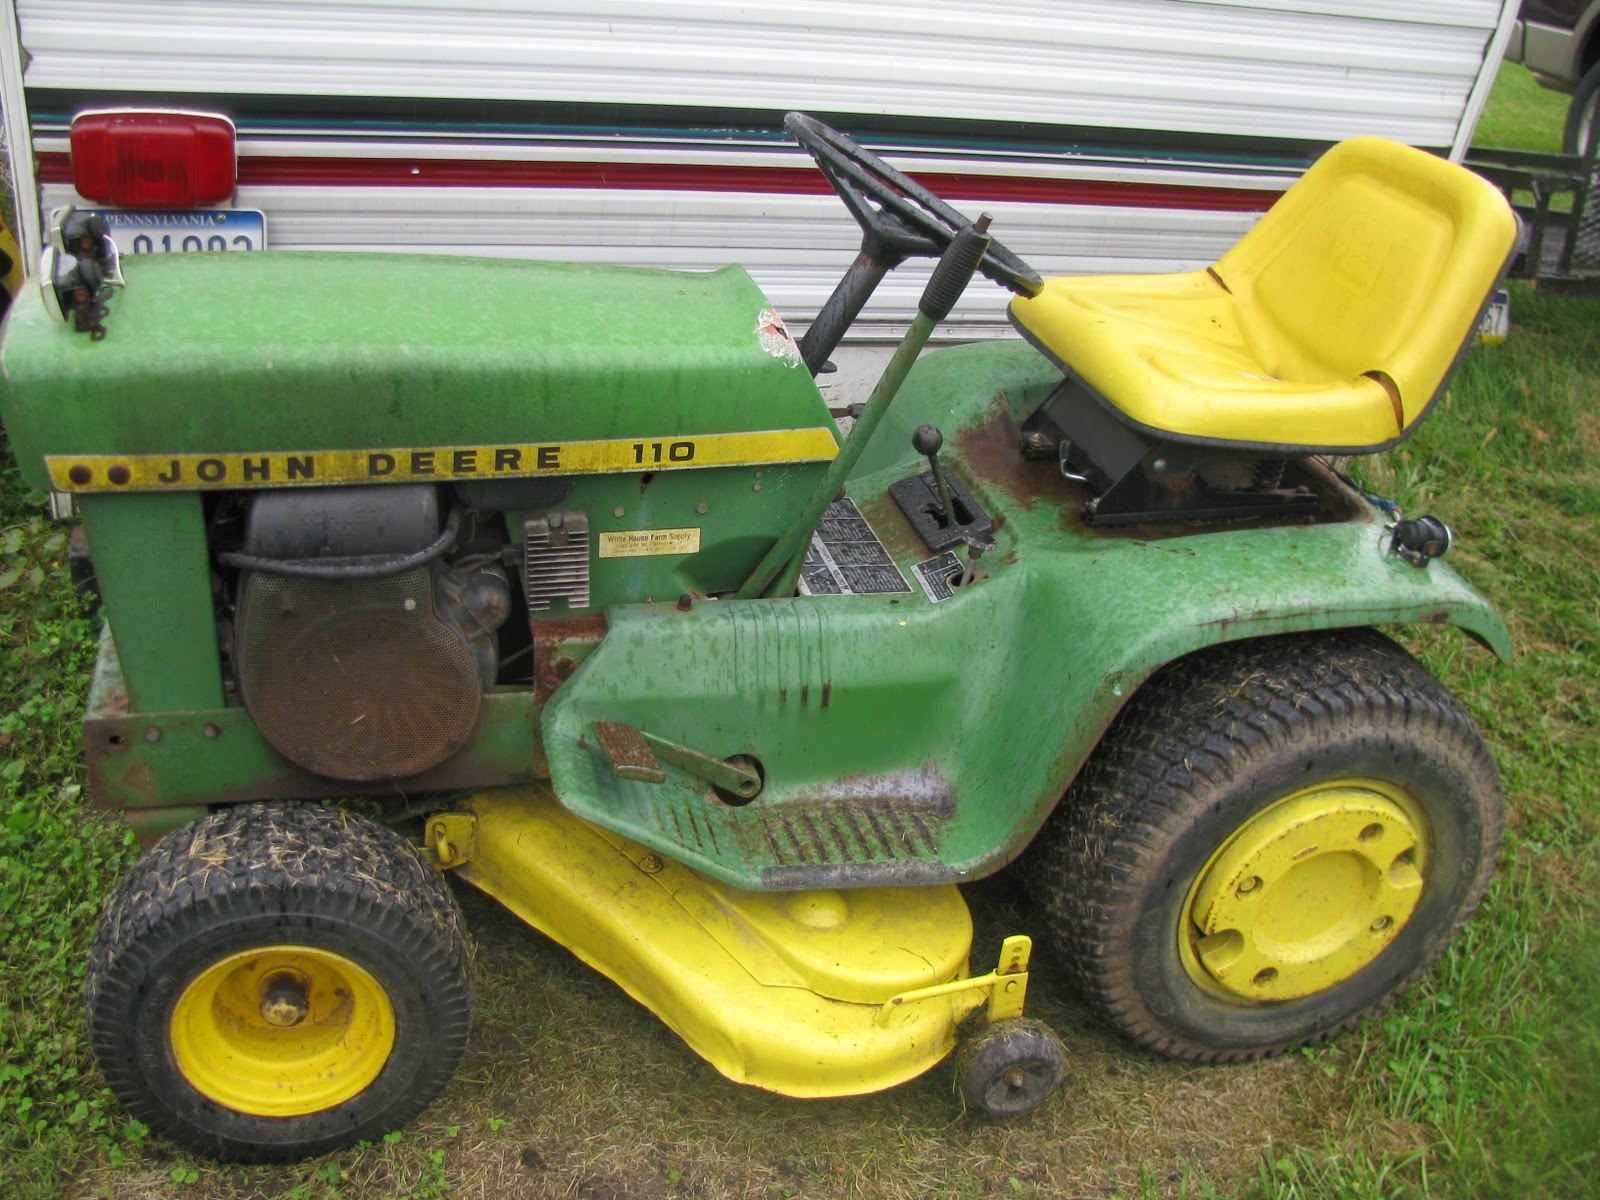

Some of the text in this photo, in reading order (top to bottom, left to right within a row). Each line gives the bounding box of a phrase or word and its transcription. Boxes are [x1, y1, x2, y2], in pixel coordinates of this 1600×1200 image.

[105, 214, 216, 227] PENNSYLVANIA
[158, 441, 696, 483] JOHN DEERE 110
[607, 532, 691, 543] White House Farm Supply
